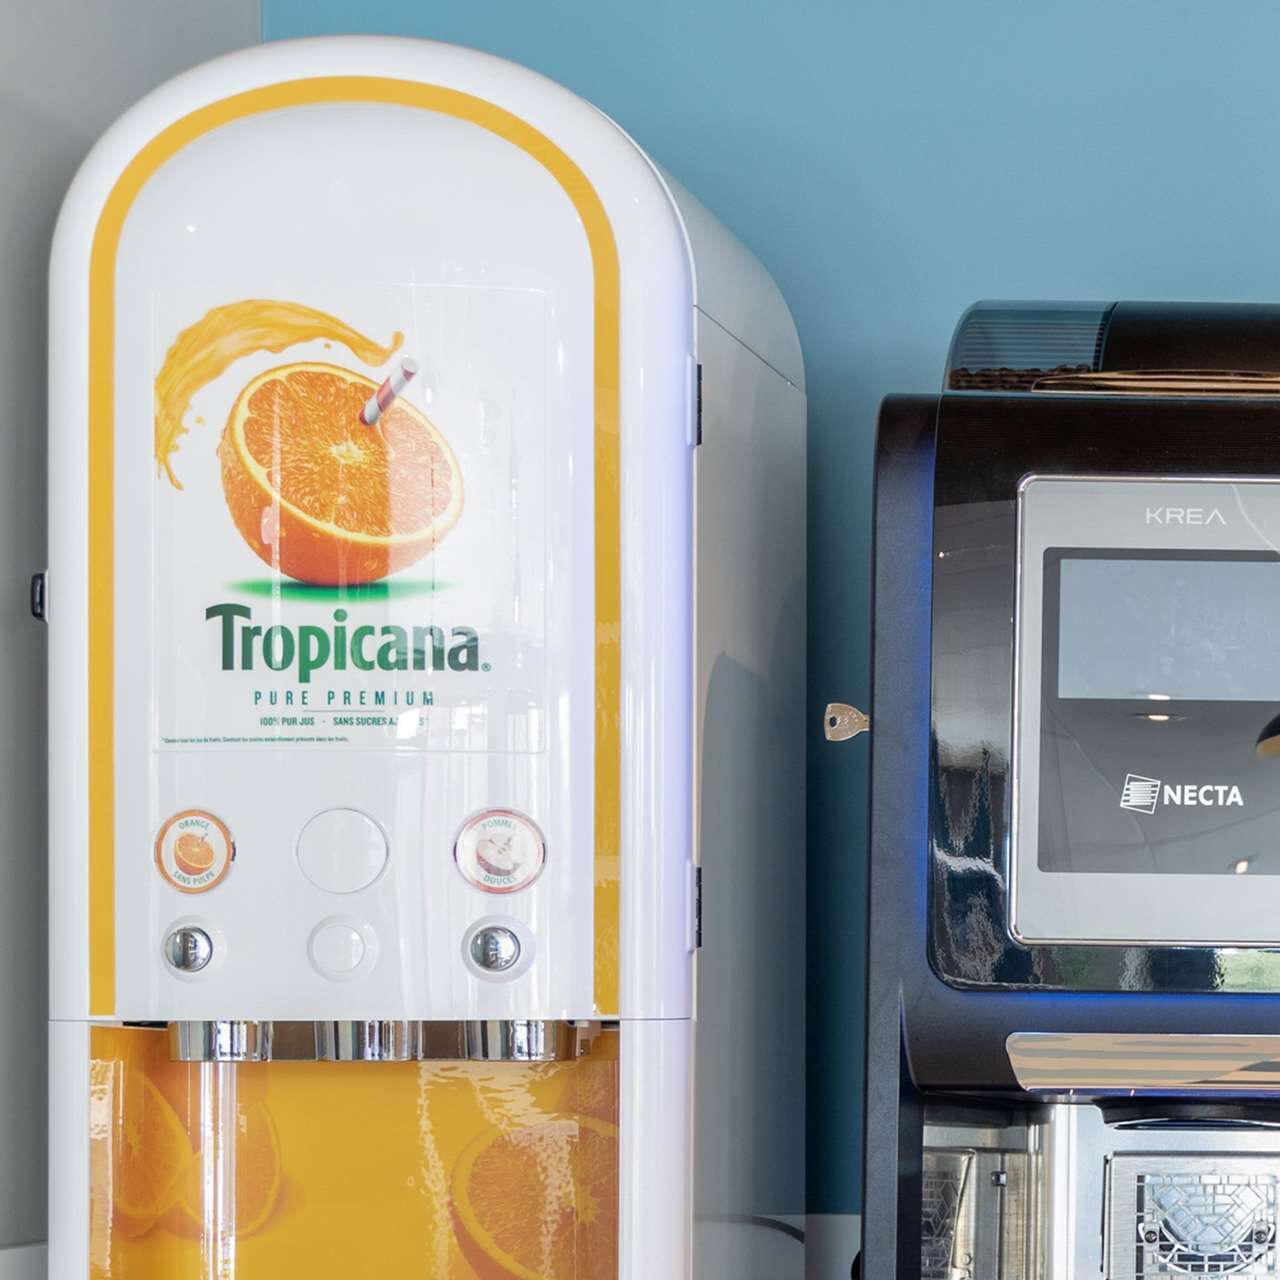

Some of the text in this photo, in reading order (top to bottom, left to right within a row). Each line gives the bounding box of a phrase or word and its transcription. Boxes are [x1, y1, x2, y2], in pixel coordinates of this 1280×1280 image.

[1145, 507, 1227, 526] KREA
[205, 603, 480, 683] Tropicana
[254, 690, 434, 706] PURE PREMIUM
[281, 716, 298, 726] PUR
[298, 716, 315, 726] JUS
[333, 716, 354, 726] SANS
[355, 716, 387, 726] SUCRES
[1163, 785, 1244, 807] NECTA
[178, 819, 210, 831] ORANGE
